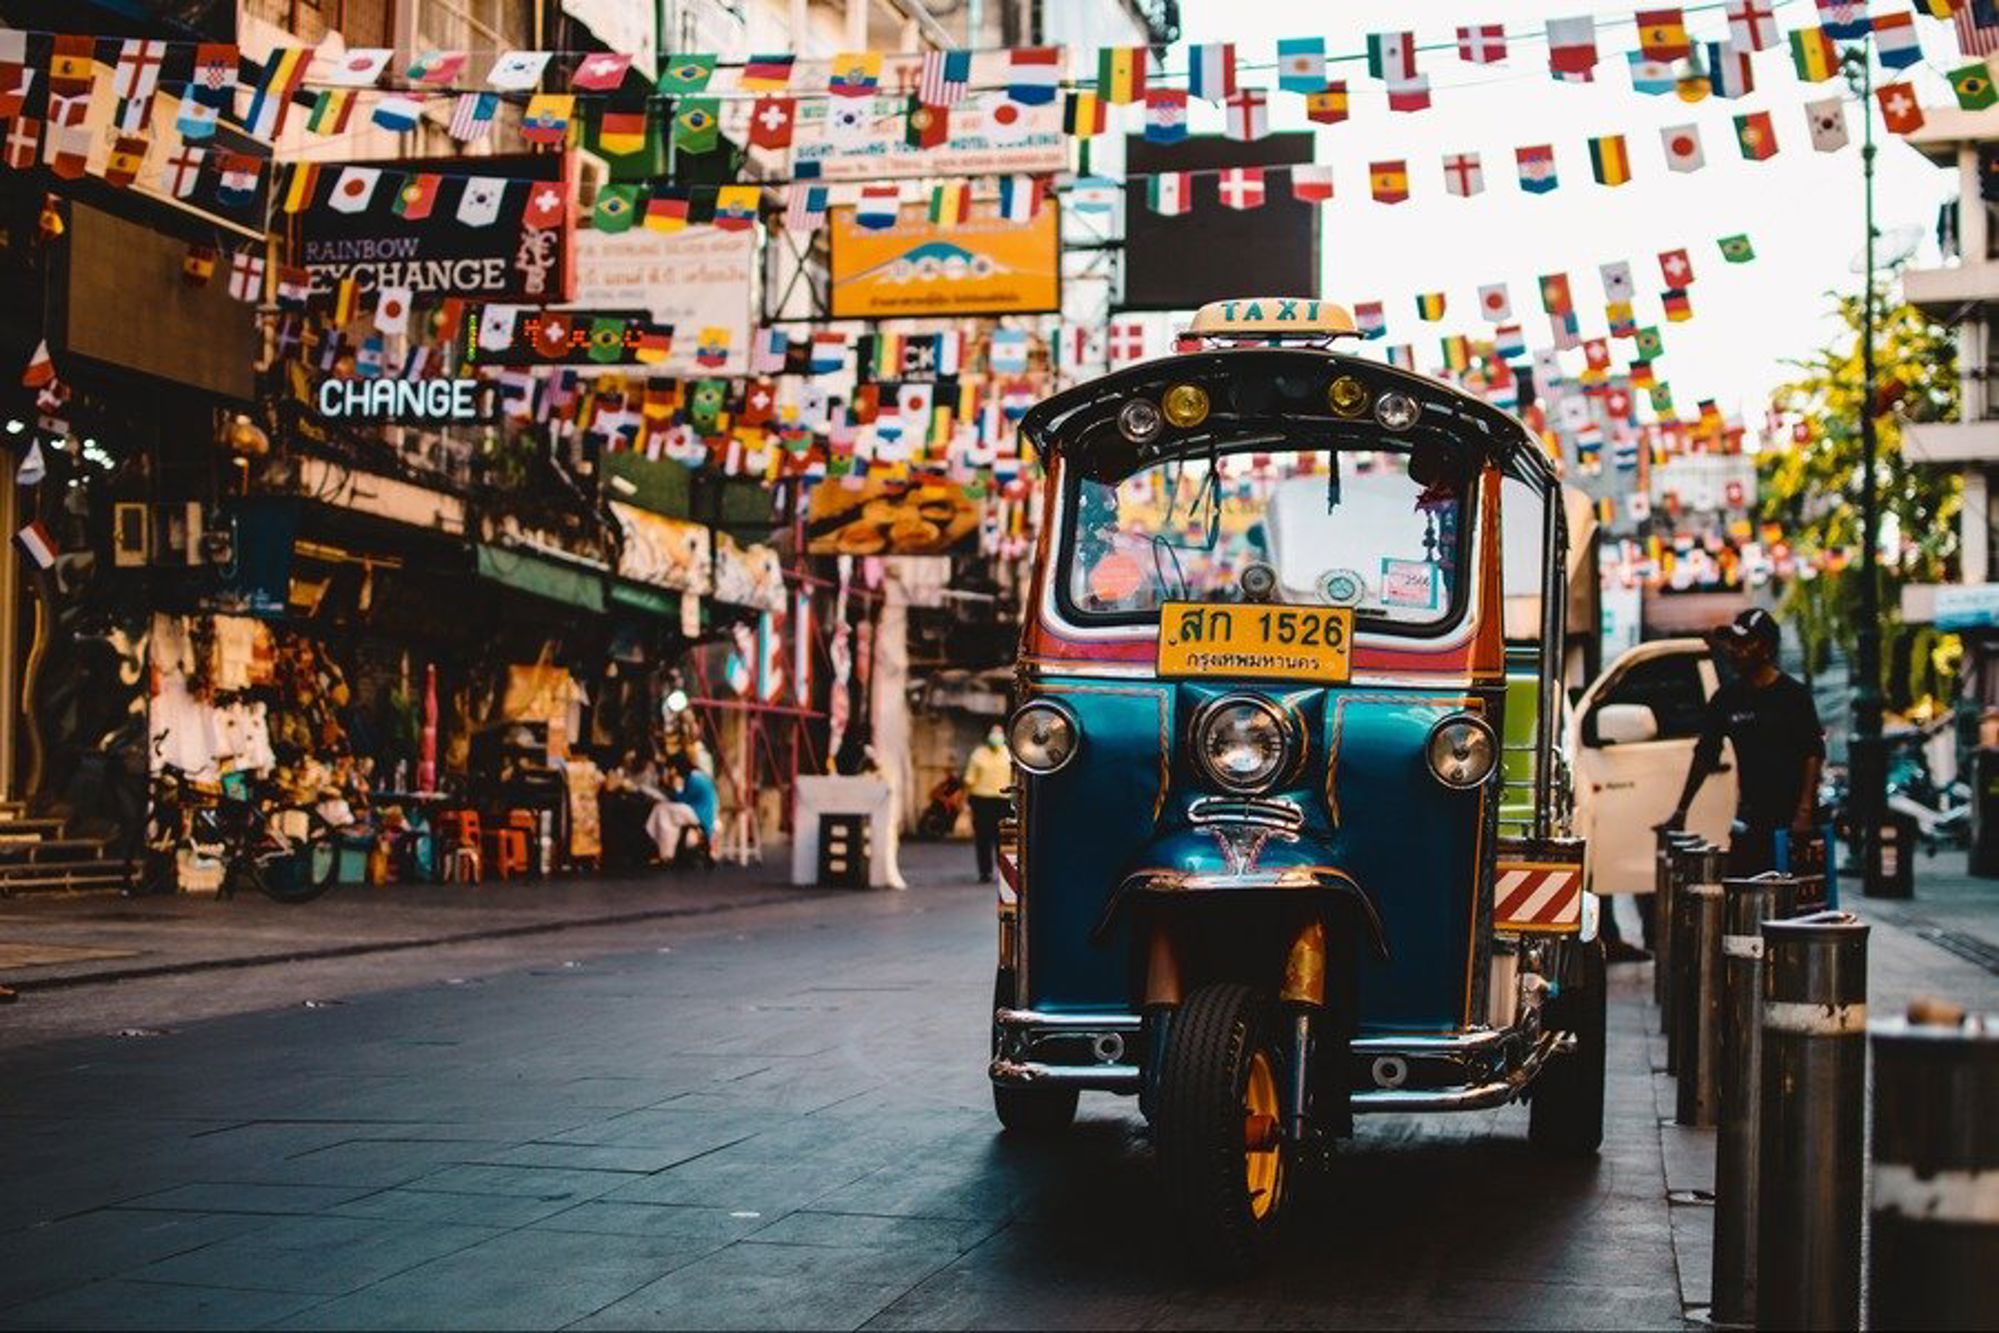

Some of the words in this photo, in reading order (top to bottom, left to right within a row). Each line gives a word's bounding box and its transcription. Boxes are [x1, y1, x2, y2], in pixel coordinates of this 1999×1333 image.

[306, 237, 420, 261] RAINBOW
[1221, 299, 1319, 321] TAXI
[319, 378, 478, 418] CHANGE
[1181, 608, 1232, 642] สก
[1259, 611, 1344, 648] 1526
[1186, 652, 1321, 672] กรุงเทพมหานคร
